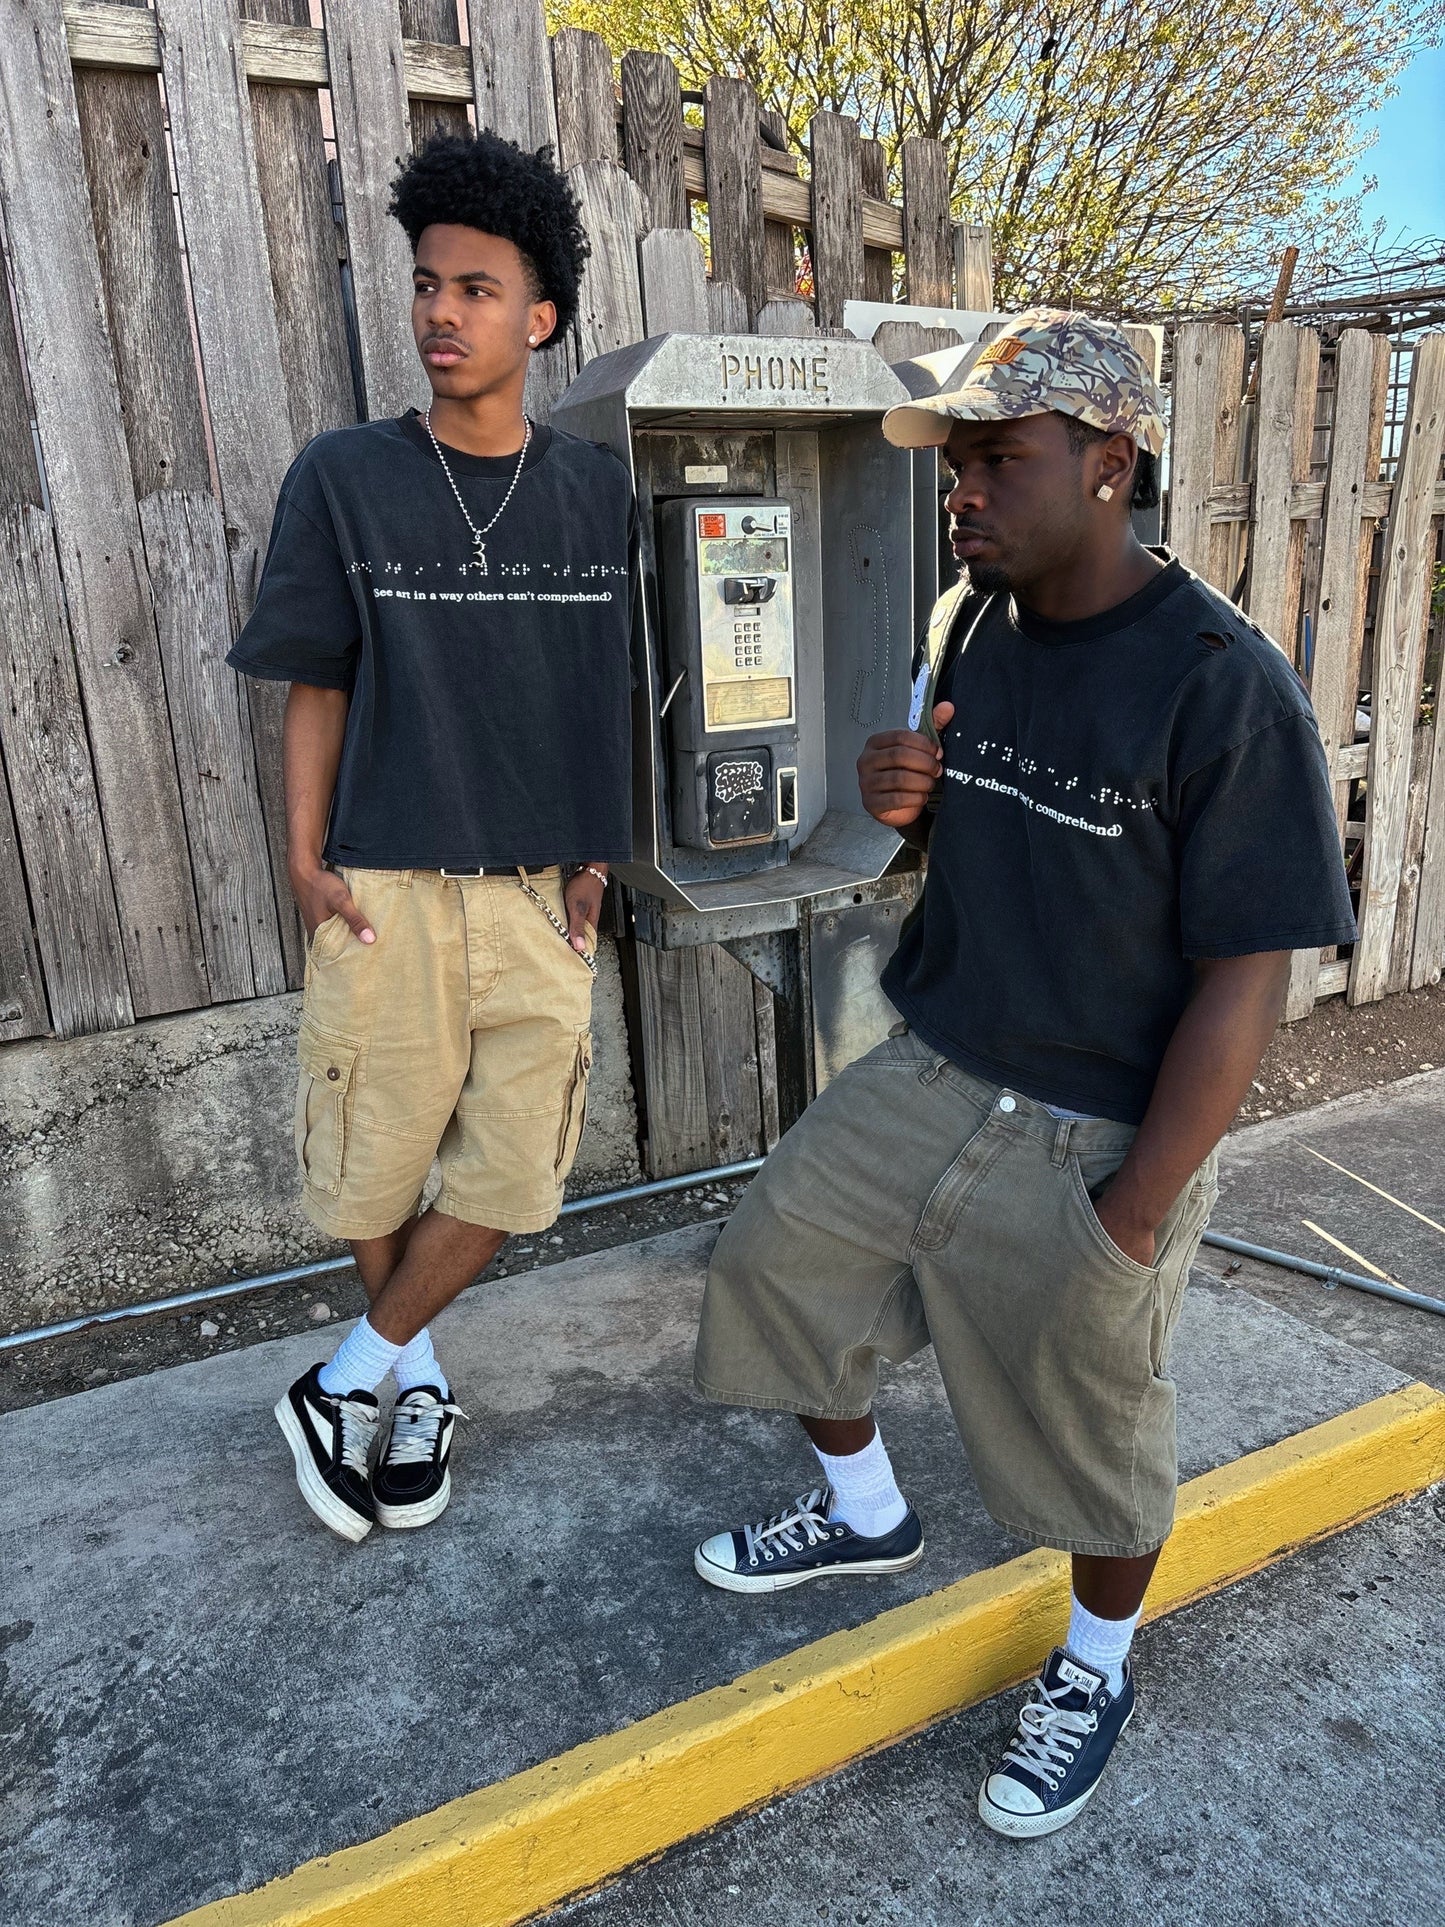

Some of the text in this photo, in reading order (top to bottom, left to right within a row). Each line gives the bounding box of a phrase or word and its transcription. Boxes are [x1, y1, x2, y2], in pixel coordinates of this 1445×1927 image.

[721, 354, 829, 391] PHONE
[395, 590, 411, 600] art
[413, 590, 427, 600] in
[429, 592, 437, 600] a
[439, 592, 464, 603] way
[466, 590, 504, 601] others
[506, 590, 536, 601] can't
[537, 591, 613, 604] comprehend)
[945, 767, 974, 785] way
[975, 776, 1018, 797] others
[1035, 802, 1123, 838] comprehend)
[1064, 1667, 1093, 1689] ALL STAR
